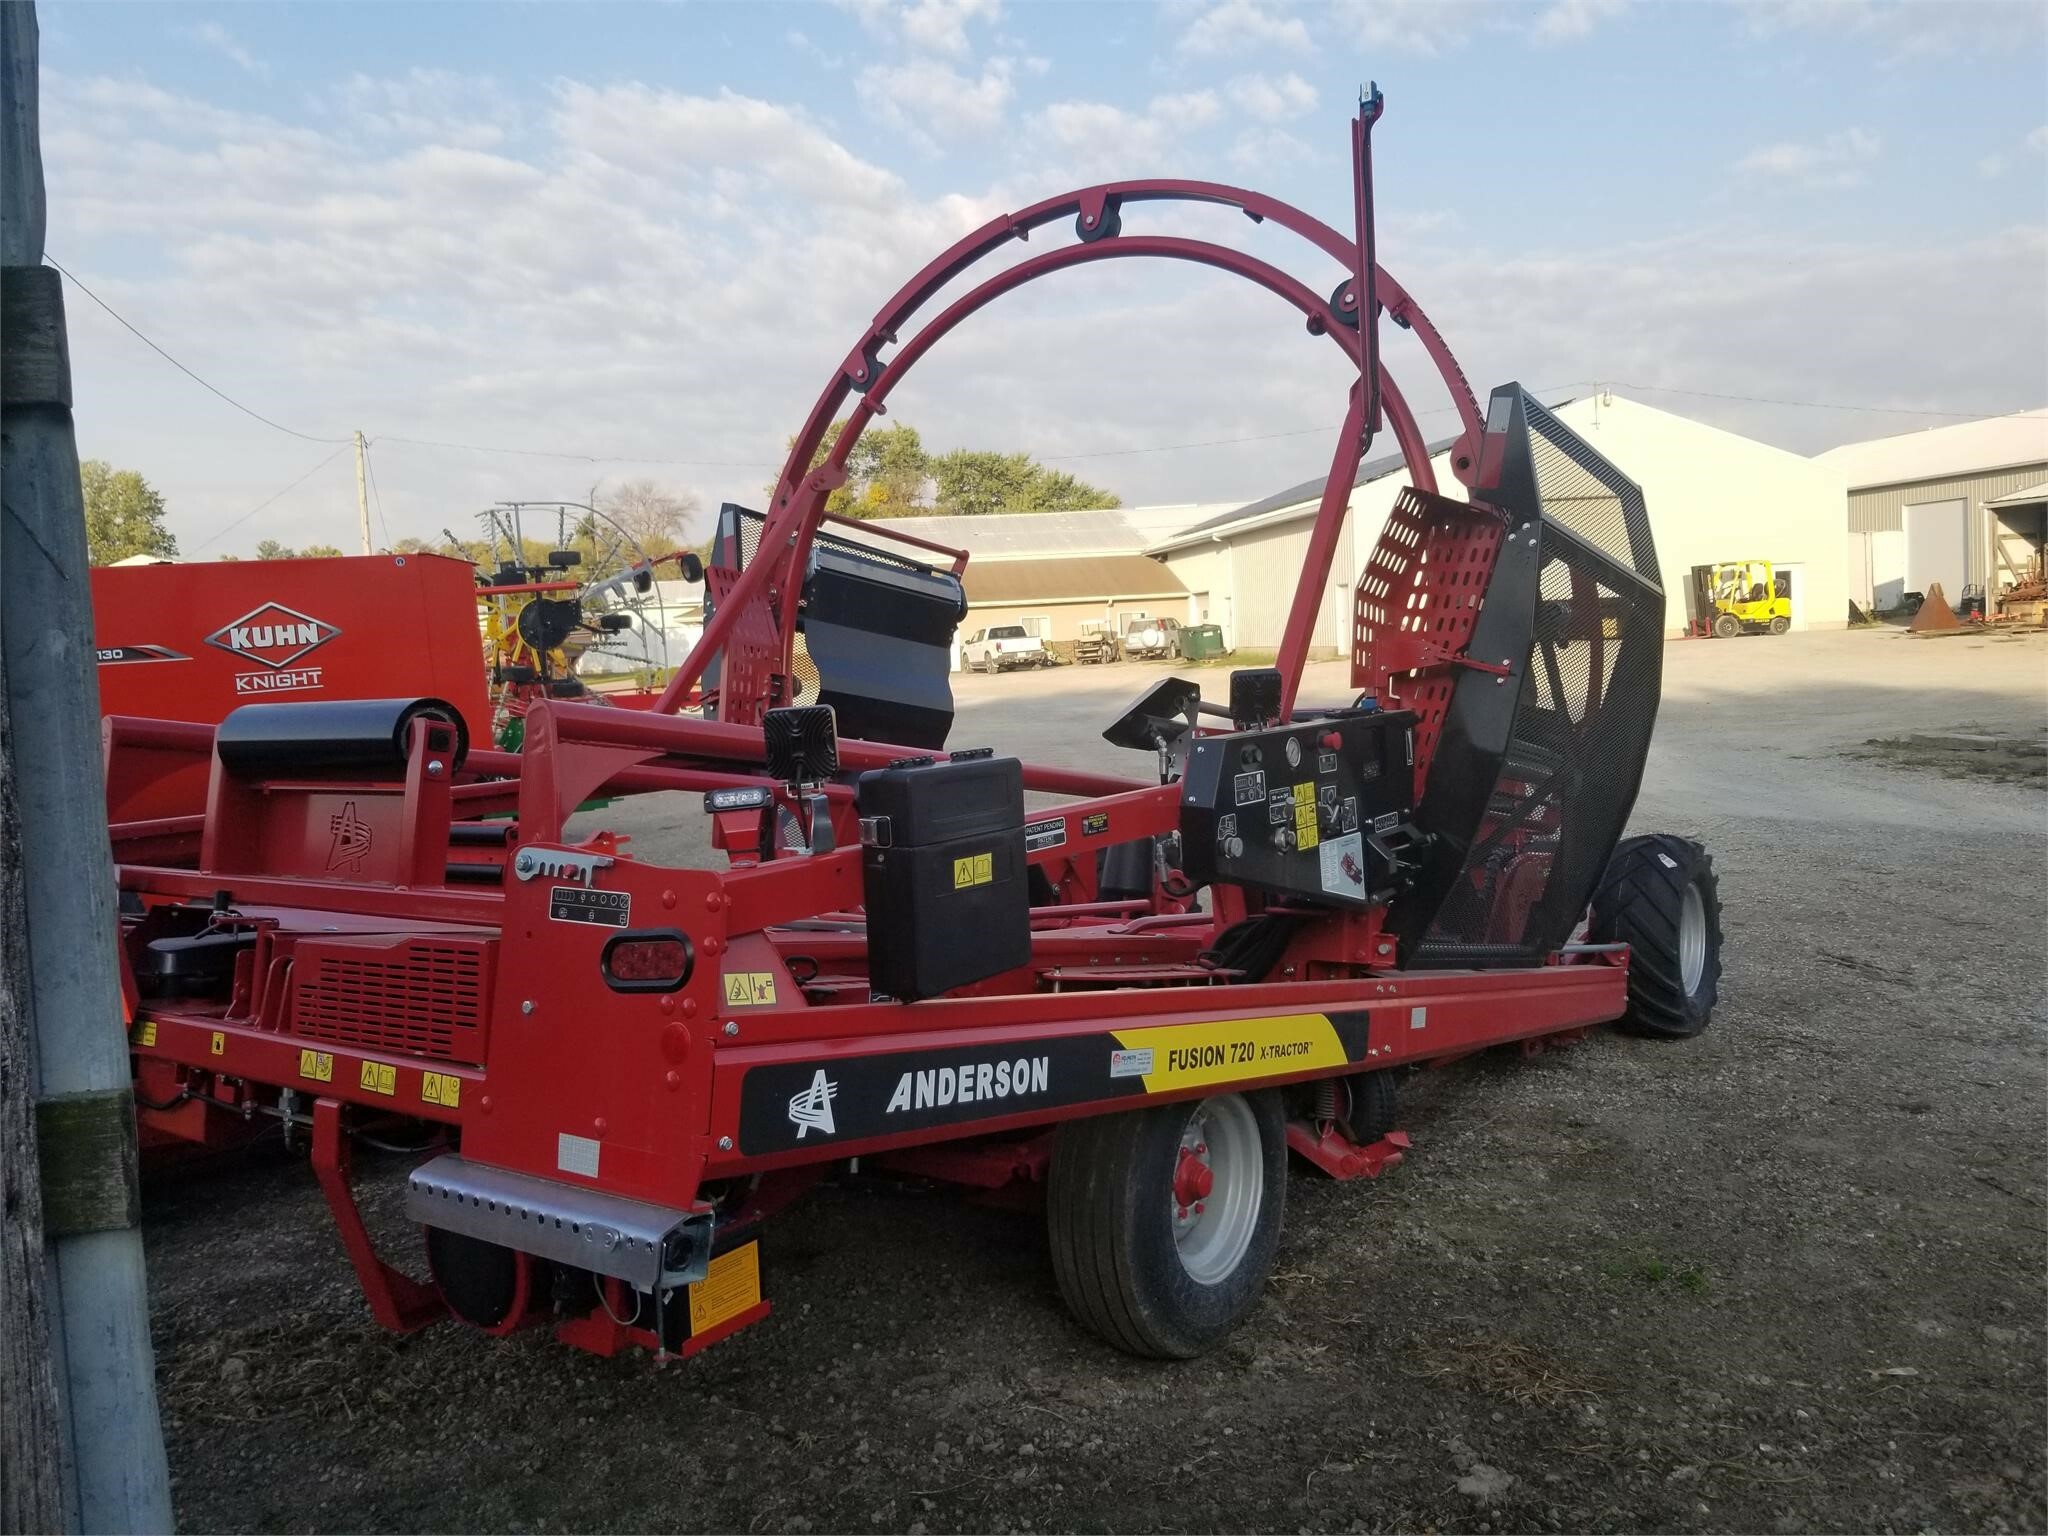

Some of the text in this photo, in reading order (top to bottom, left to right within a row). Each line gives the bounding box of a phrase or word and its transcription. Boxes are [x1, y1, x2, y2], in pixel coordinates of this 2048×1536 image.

[230, 623, 319, 649] KUHN
[96, 649, 123, 660] 130
[235, 671, 322, 691] KNIGHT
[1026, 820, 1064, 834] PATENT PENDING
[1168, 1044, 1225, 1072] FUSION
[1230, 1041, 1255, 1063] 720
[885, 1056, 1049, 1113] ANDERSON
